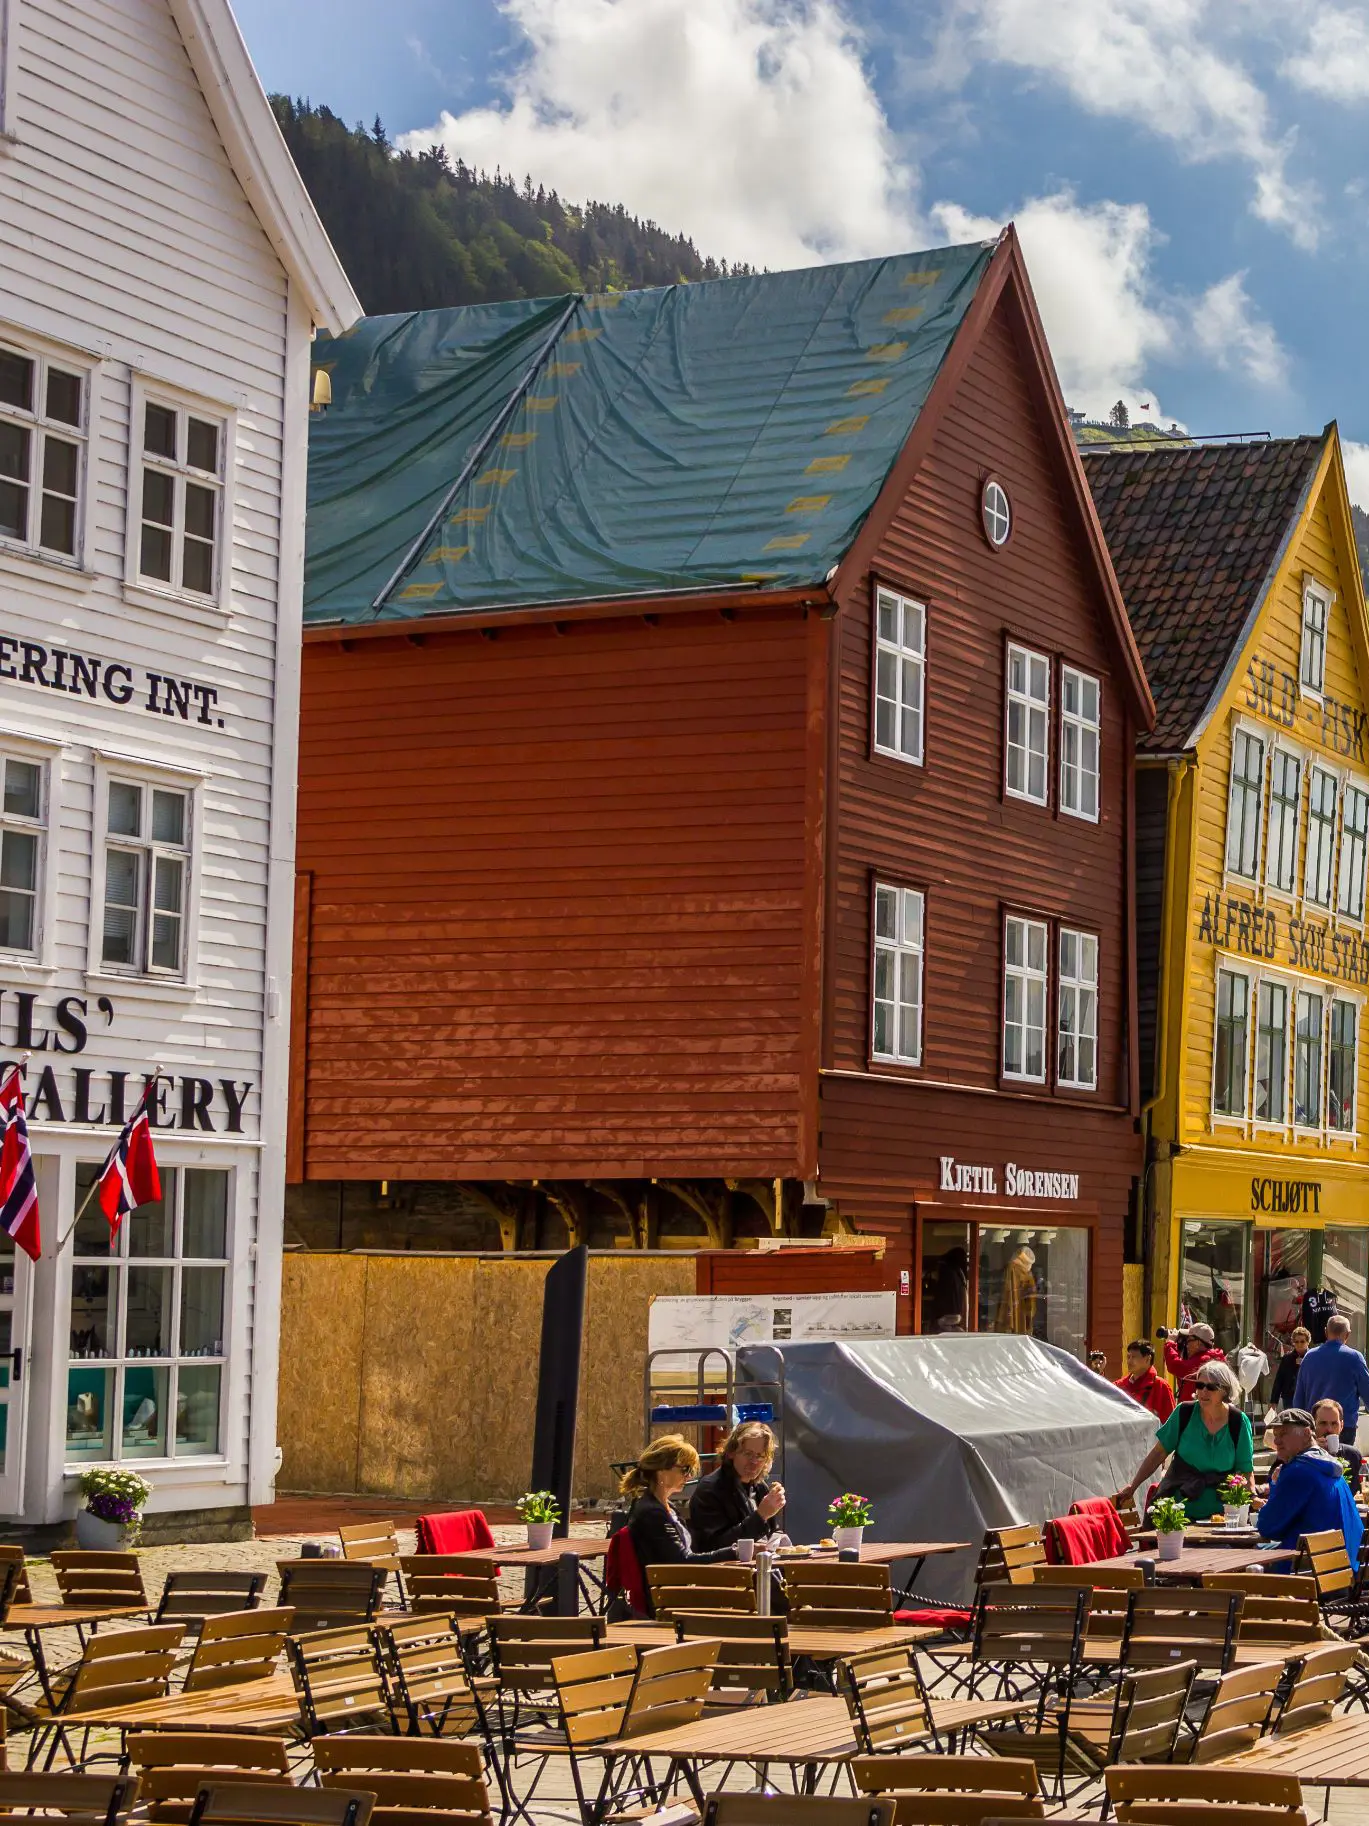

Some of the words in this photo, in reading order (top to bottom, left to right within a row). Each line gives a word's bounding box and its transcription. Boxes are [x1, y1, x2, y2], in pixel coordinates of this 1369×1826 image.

[145, 672, 225, 728] INT.
[1246, 655, 1296, 728] SILD
[1322, 696, 1368, 764] FISK
[1198, 891, 1276, 959] ALFRED
[0, 989, 114, 1054] LS'
[1251, 1177, 1321, 1213] SCHJØTT
